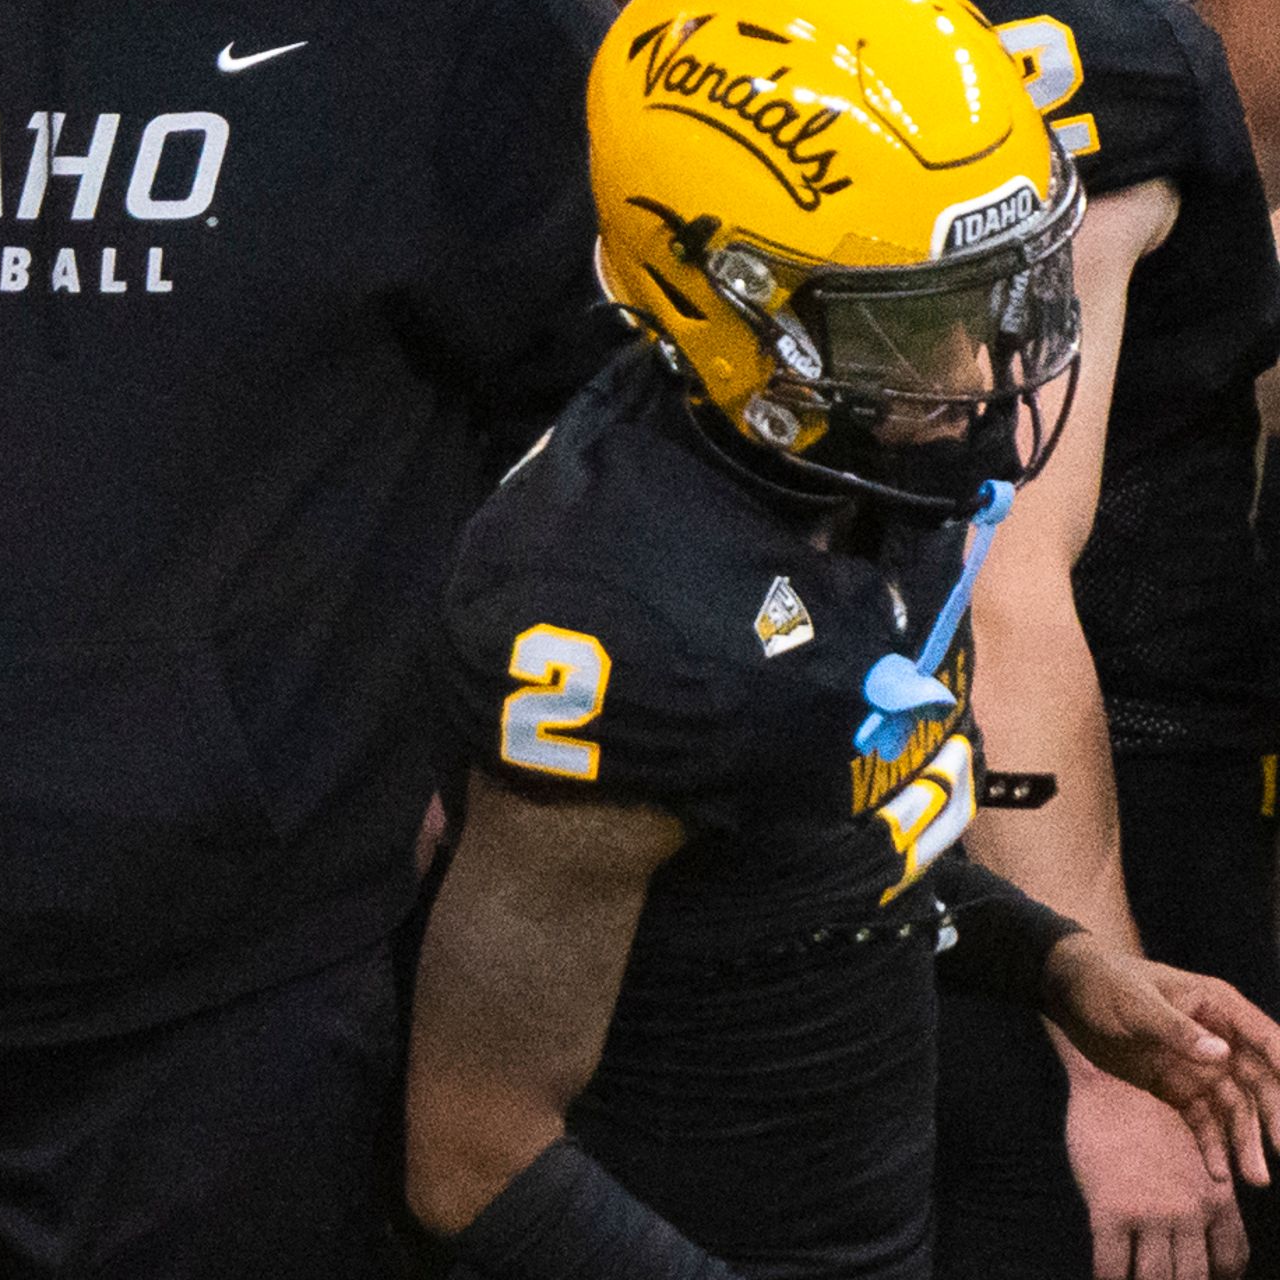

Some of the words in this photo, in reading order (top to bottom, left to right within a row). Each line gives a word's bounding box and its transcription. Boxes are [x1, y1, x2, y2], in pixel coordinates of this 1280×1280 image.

[629, 13, 836, 190] Vandals
[953, 188, 1033, 247] IDAHO
[499, 622, 612, 782] 2
